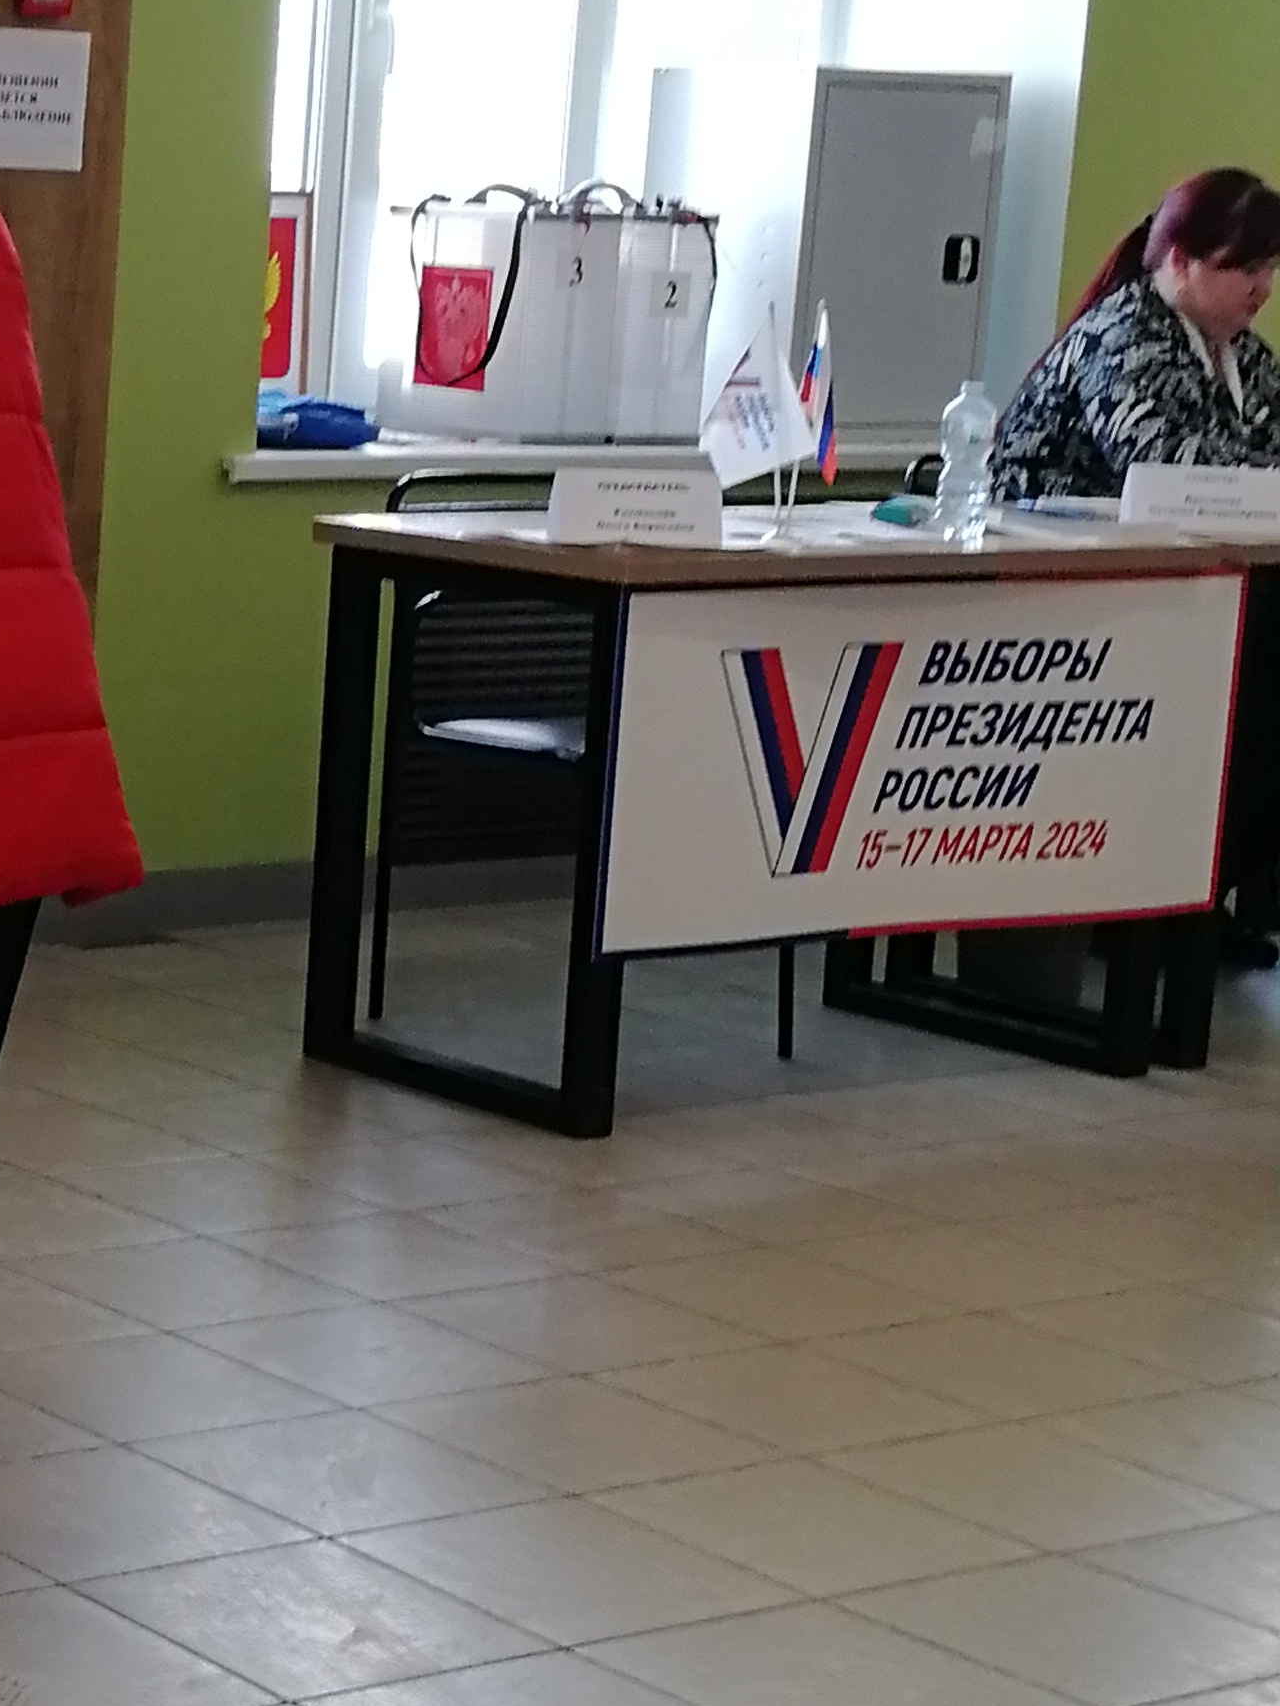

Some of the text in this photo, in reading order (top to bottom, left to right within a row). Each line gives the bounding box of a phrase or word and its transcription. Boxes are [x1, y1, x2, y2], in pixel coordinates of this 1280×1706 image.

[568, 256, 583, 287] 3
[663, 280, 678, 309] 2
[918, 637, 1113, 685] ВЫБОРЫ
[895, 698, 1154, 753] ПРЕЗИДЕНТА
[872, 762, 1041, 814] РОССИИ
[931, 823, 1034, 866] МАРТА
[1036, 819, 1109, 861] 2024
